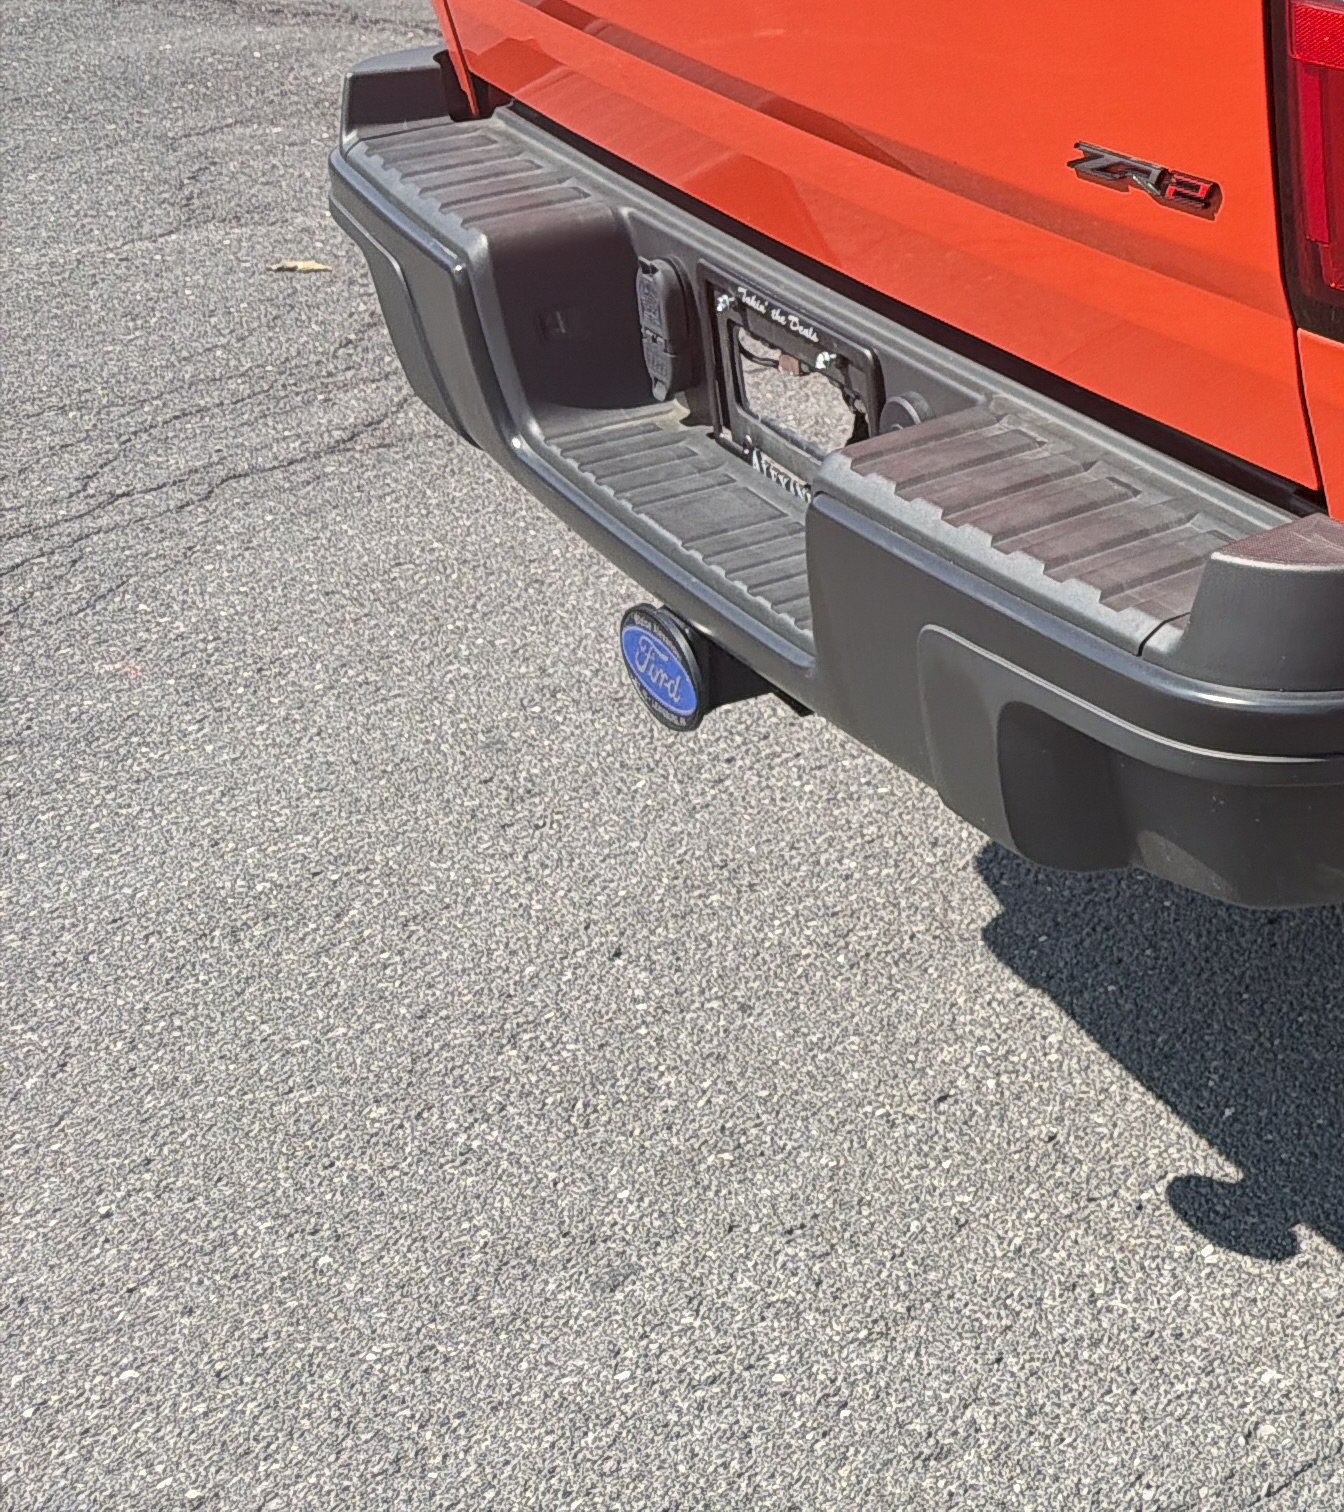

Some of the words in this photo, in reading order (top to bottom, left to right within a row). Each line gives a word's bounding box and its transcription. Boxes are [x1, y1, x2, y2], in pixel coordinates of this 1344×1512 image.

[1066, 141, 1221, 219] ZR2
[770, 307, 787, 325] the
[752, 447, 812, 503] ALEXAN
[635, 635, 681, 703] Ford
